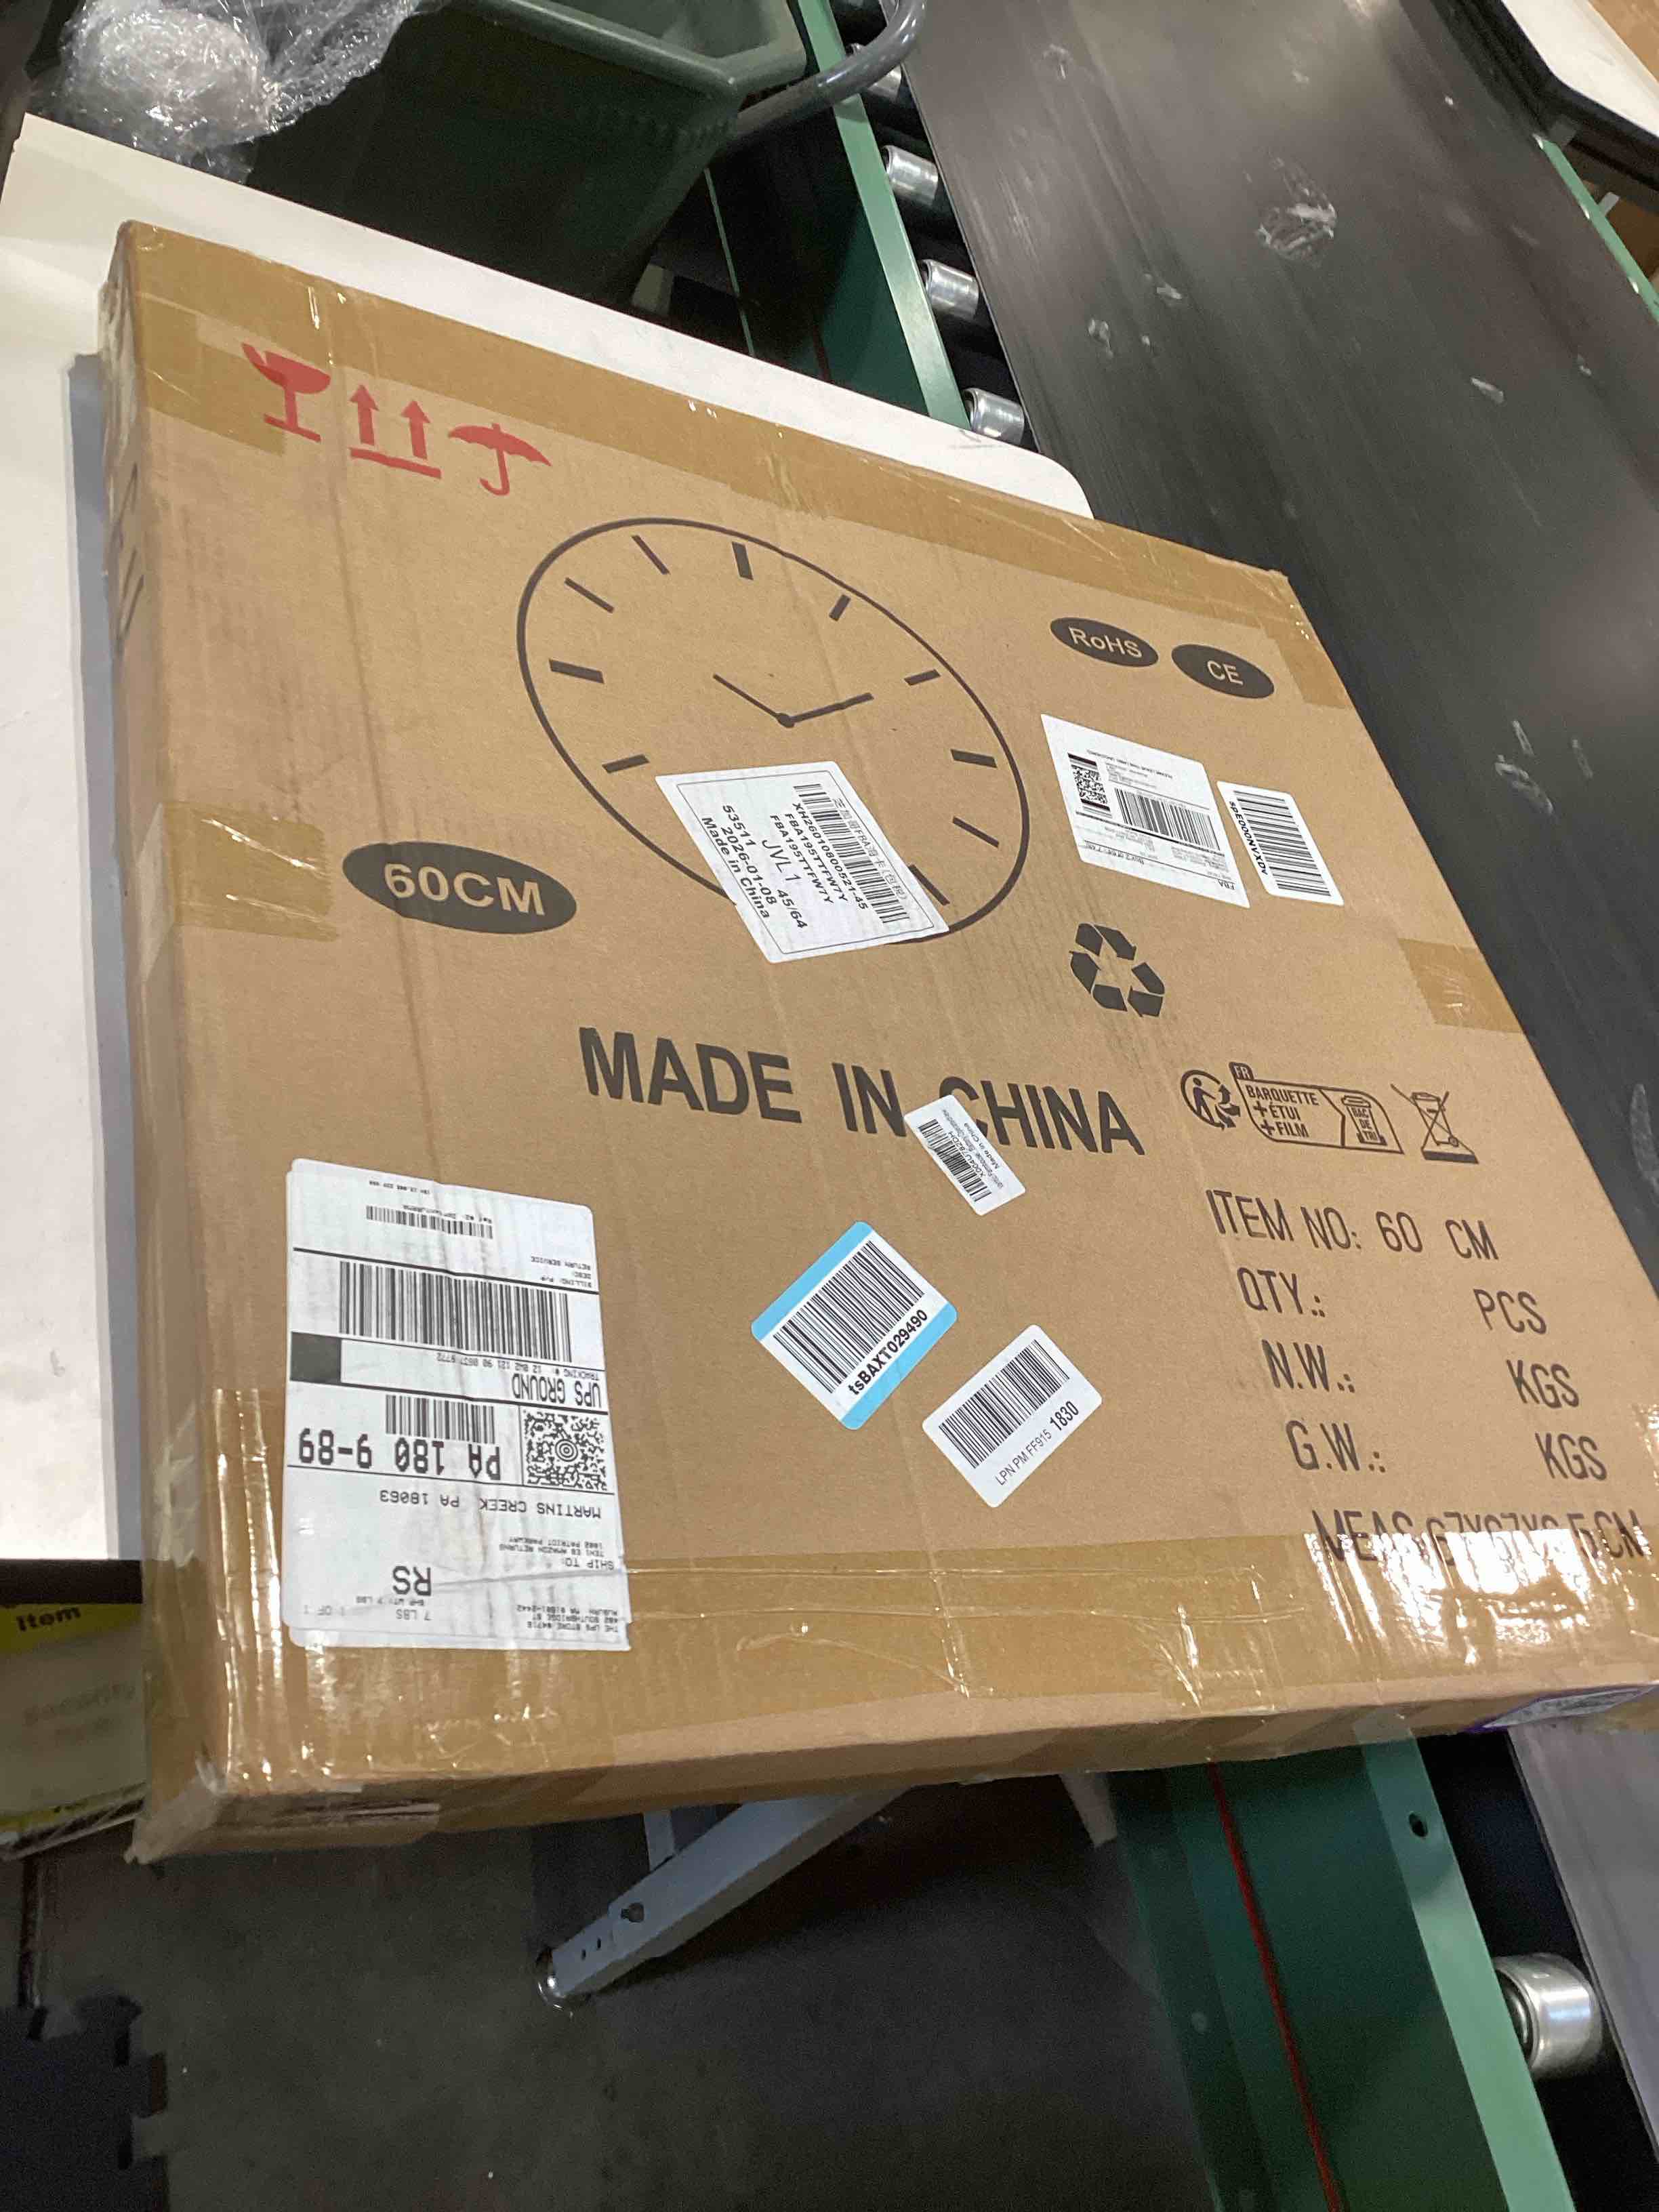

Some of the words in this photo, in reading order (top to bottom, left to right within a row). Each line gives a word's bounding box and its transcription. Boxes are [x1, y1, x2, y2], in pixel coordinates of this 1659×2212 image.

[1068, 626, 1143, 658] RoHS
[1206, 659, 1244, 685] CE
[701, 817, 733, 855] Made
[727, 859, 744, 872] in
[739, 878, 773, 918] China
[720, 826, 777, 904] 2026-01-08
[721, 805, 756, 846] 53511
[775, 888, 808, 928] 45/64
[769, 815, 834, 904] FBA195TTFW7Y
[783, 813, 848, 901] FBA195TTFW7Y
[384, 863, 546, 916] 60CM
[579, 1027, 802, 1124] MADE
[832, 1062, 906, 1137] IN
[1233, 1065, 1250, 1080] FR
[1245, 1084, 1319, 1106] BARQUETTE
[1359, 1118, 1372, 1130] DE
[1363, 1130, 1378, 1141] TRI
[1206, 1189, 1294, 1242] ITEM
[1300, 1206, 1361, 1250] NO:
[1376, 1211, 1423, 1252] 60
[1445, 1219, 1499, 1260] CM
[1473, 1288, 1547, 1334] PCS
[848, 1309, 928, 1396] tsBAXT029490
[511, 1372, 565, 1404] GROUND
[573, 1380, 601, 1408] UPS
[1506, 1359, 1580, 1409] KGS
[1049, 1399, 1080, 1433] 1830
[298, 1427, 372, 1469] 9-89
[393, 1436, 445, 1475] 180
[467, 1443, 500, 1481] PA
[1535, 1431, 1607, 1481] KGS
[379, 1490, 428, 1505] 18063
[439, 1494, 459, 1507] PA
[478, 1497, 527, 1512] CREEK
[537, 1502, 600, 1518] MARTINS
[392, 1565, 431, 1596] RS
[586, 1558, 614, 1570] SHIP
